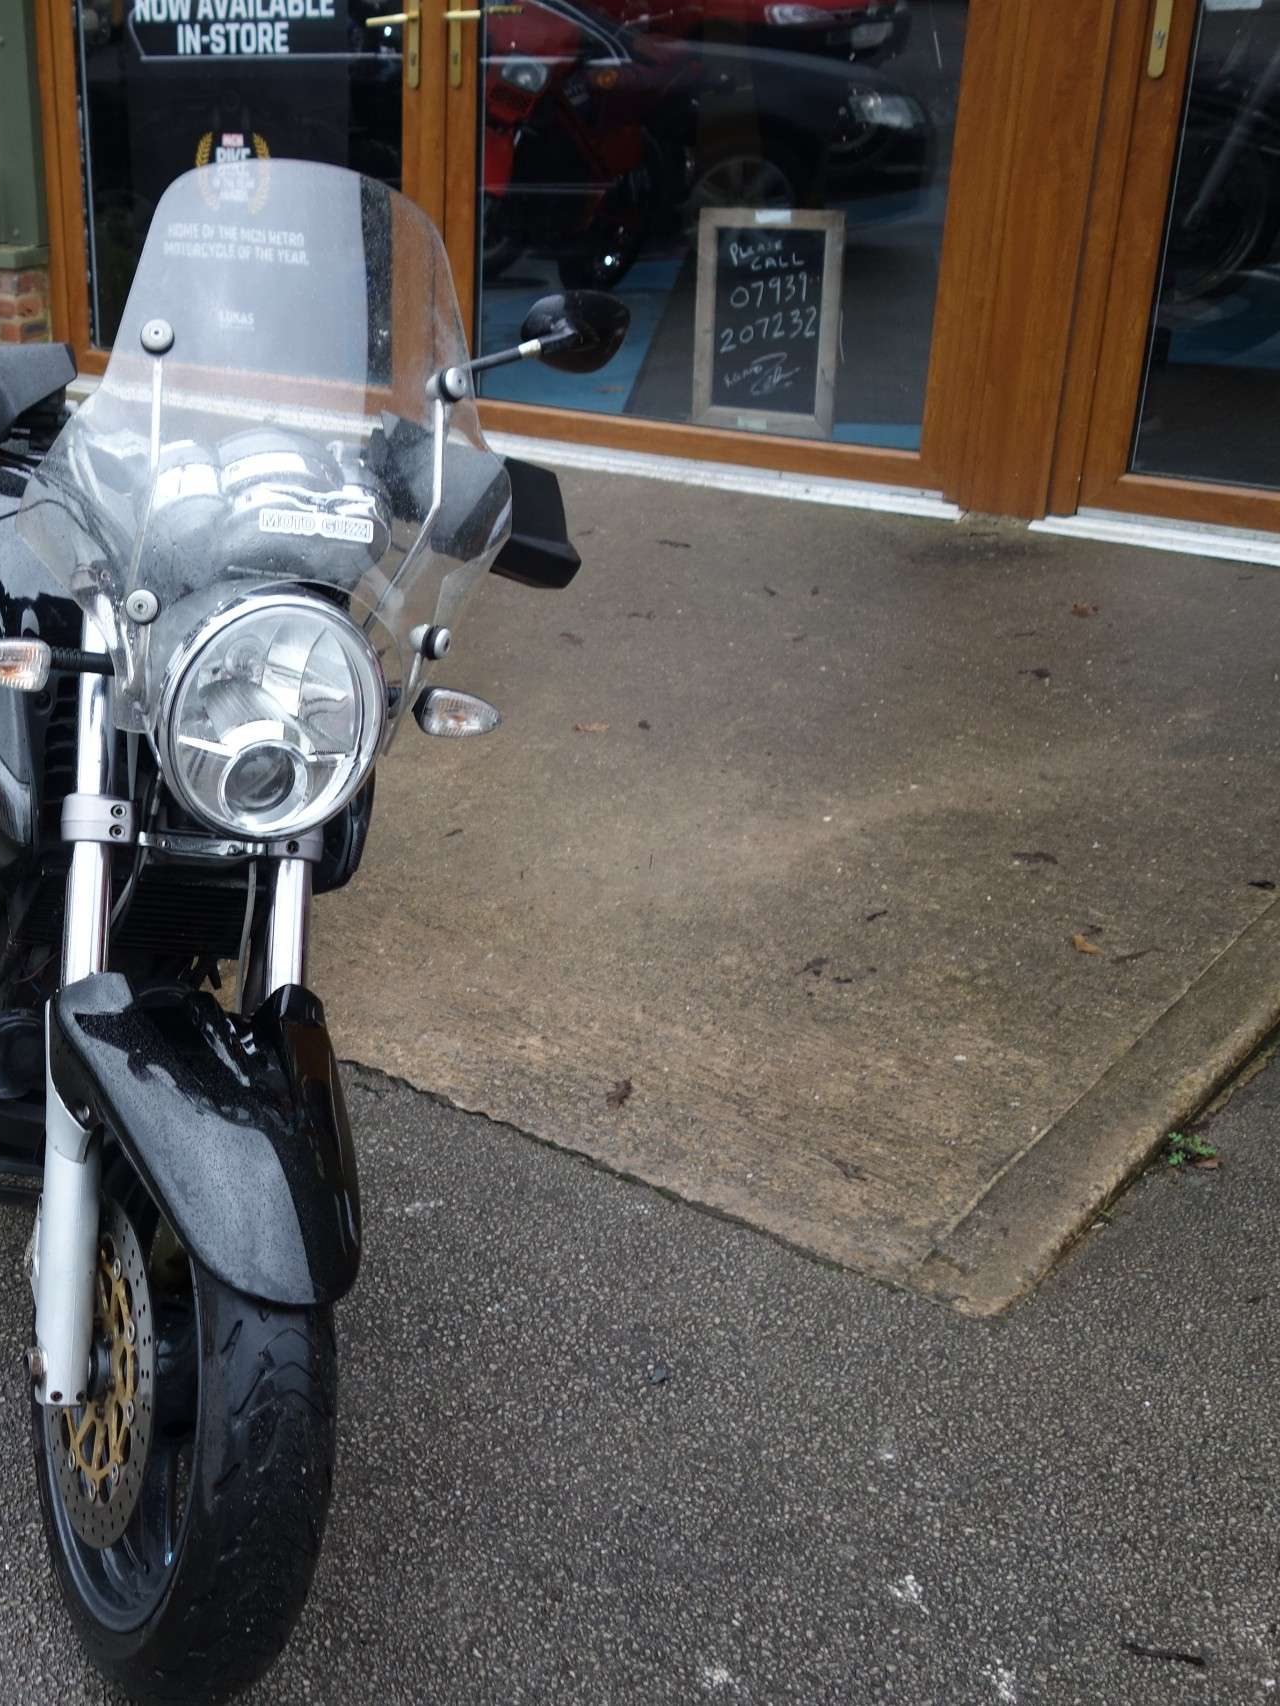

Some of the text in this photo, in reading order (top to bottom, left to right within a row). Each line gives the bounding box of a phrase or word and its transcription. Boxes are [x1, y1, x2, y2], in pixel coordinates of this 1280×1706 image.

[135, 0, 335, 21] NOW AVAILABLE
[177, 21, 289, 54] IN-STORE
[168, 223, 201, 239] HOME
[218, 225, 238, 241] THE
[268, 230, 305, 247] RETRO
[163, 240, 236, 258] MOTORCYCLE
[238, 245, 251, 259] OF
[254, 246, 275, 262] THE
[750, 252, 805, 270] CALL
[730, 271, 807, 309] 07939
[719, 305, 817, 353] 207232
[262, 510, 372, 539] MOTO GUZZI
